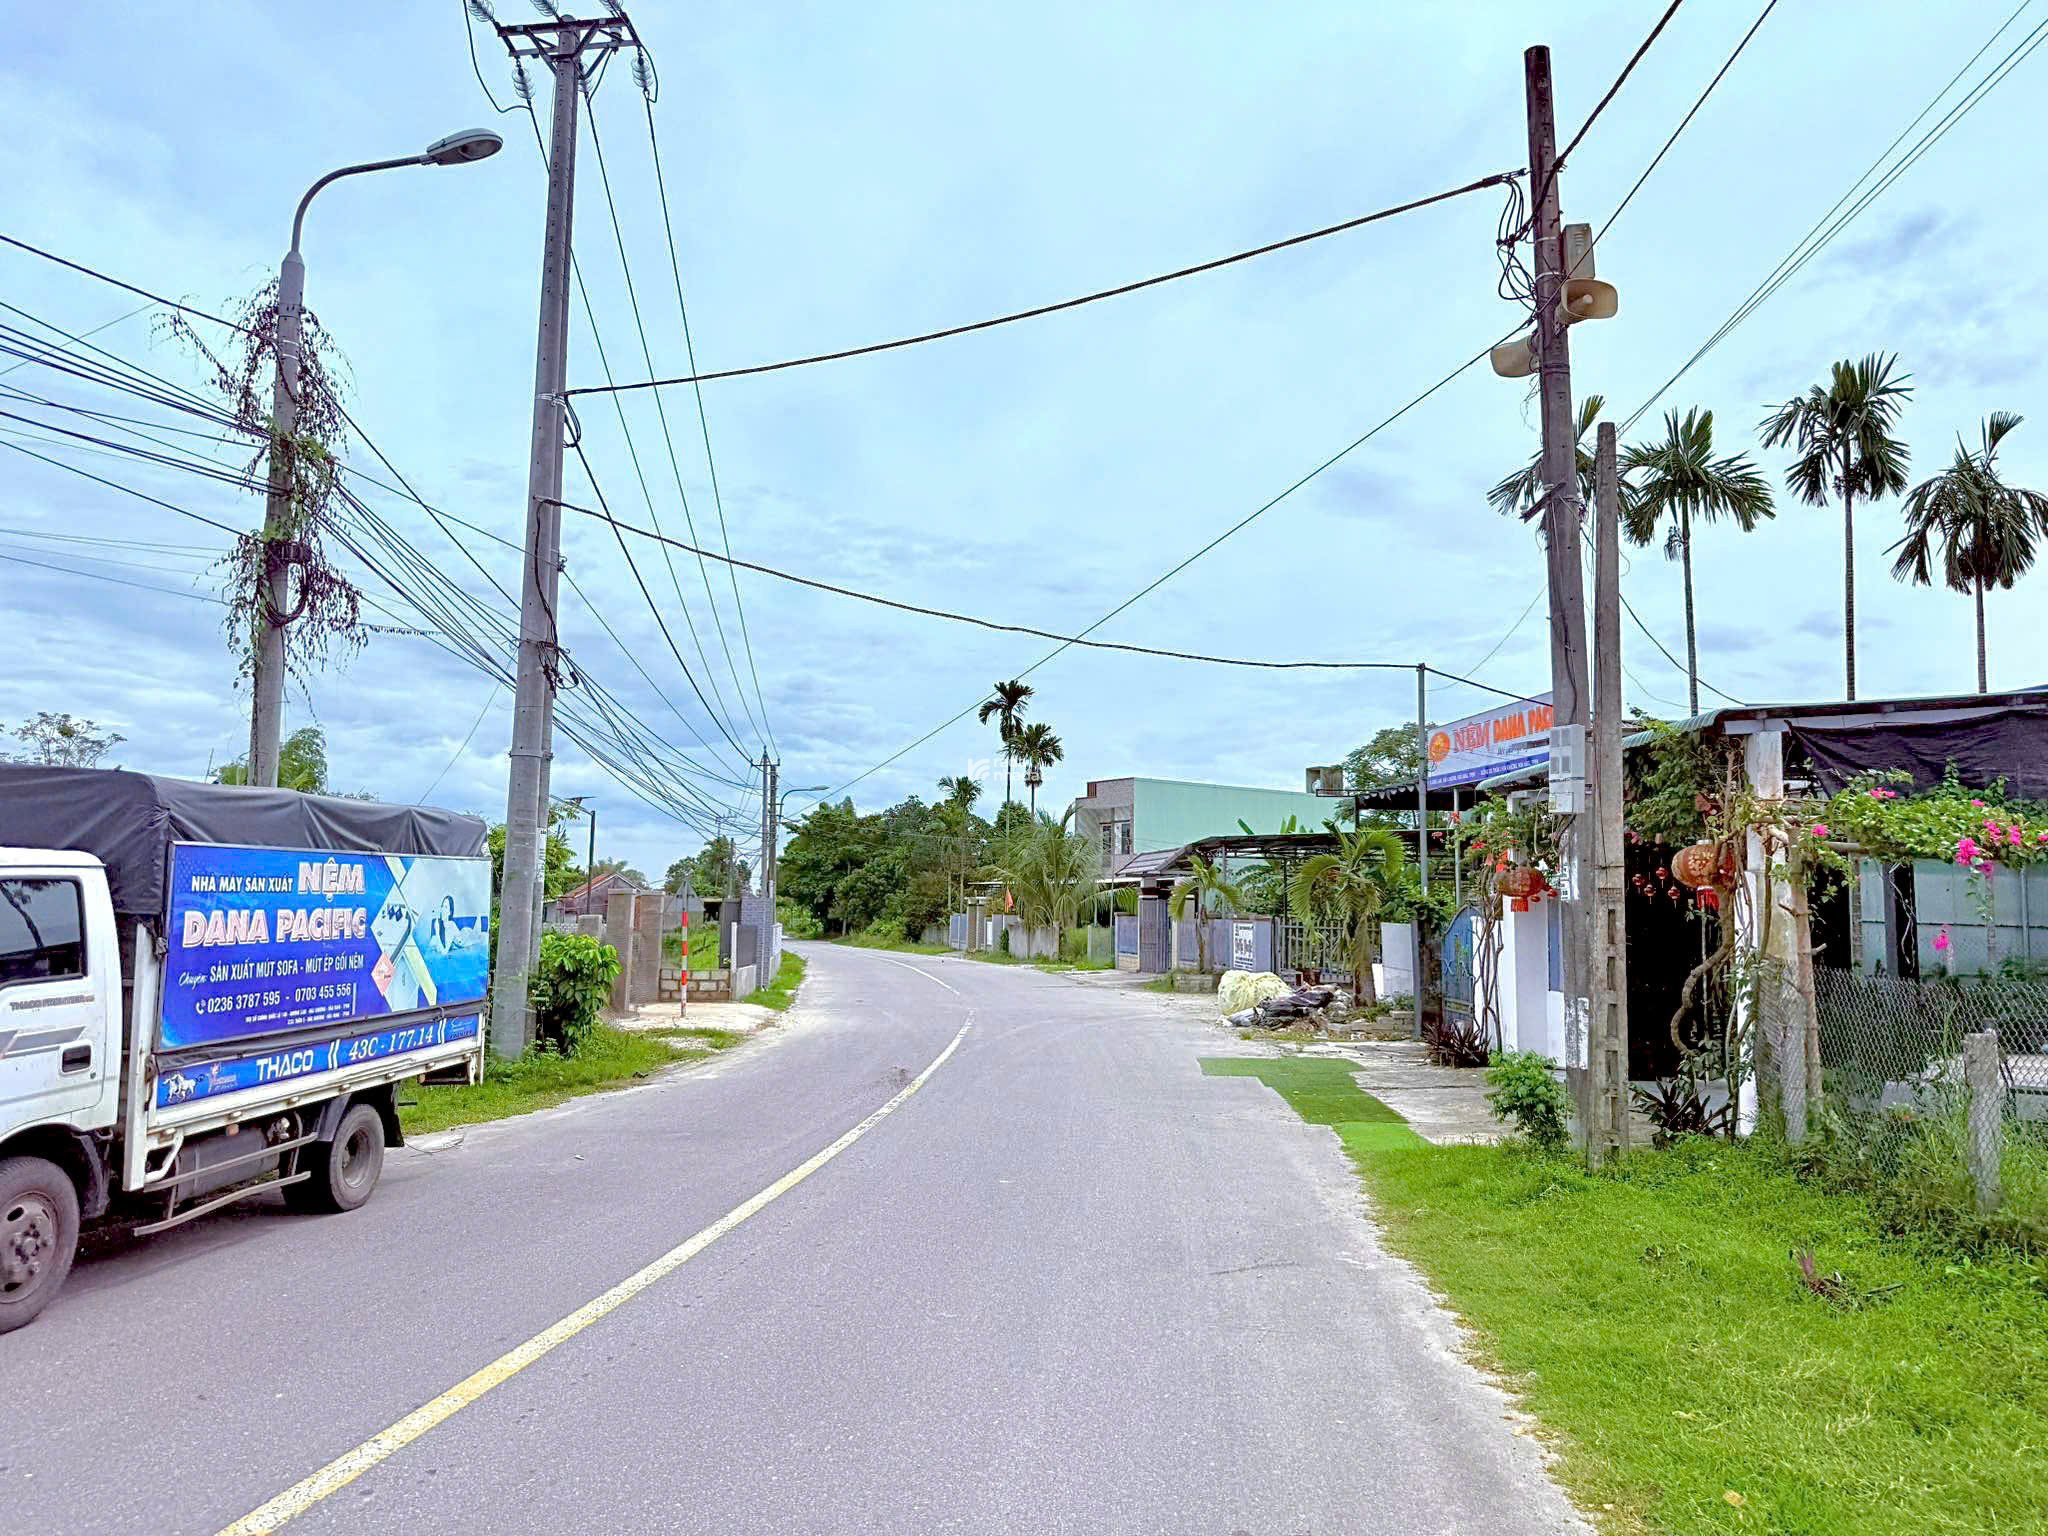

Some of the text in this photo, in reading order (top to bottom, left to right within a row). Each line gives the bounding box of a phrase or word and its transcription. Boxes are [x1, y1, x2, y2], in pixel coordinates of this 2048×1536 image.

[1494, 711, 1526, 743] DANA
[191, 857, 366, 903] NHÀ MÁY SẢN XUẤT NỆM
[183, 907, 368, 948] DANA PACIFIC
[210, 960, 229, 982] SẢN
[230, 957, 254, 980] XUẤT
[256, 958, 275, 978] MÚT
[277, 959, 298, 976] SOFA
[305, 955, 323, 974] MÚT
[323, 953, 334, 972] ÉP
[207, 996, 233, 1013] 0236
[235, 993, 261, 1010] 3787
[262, 990, 280, 1006] 595
[295, 987, 317, 1002] 0703
[318, 985, 335, 999] 455
[336, 982, 352, 997] 556
[348, 1037, 379, 1061] 43C
[388, 1025, 434, 1052] 177.14
[256, 1049, 314, 1081] THACO
